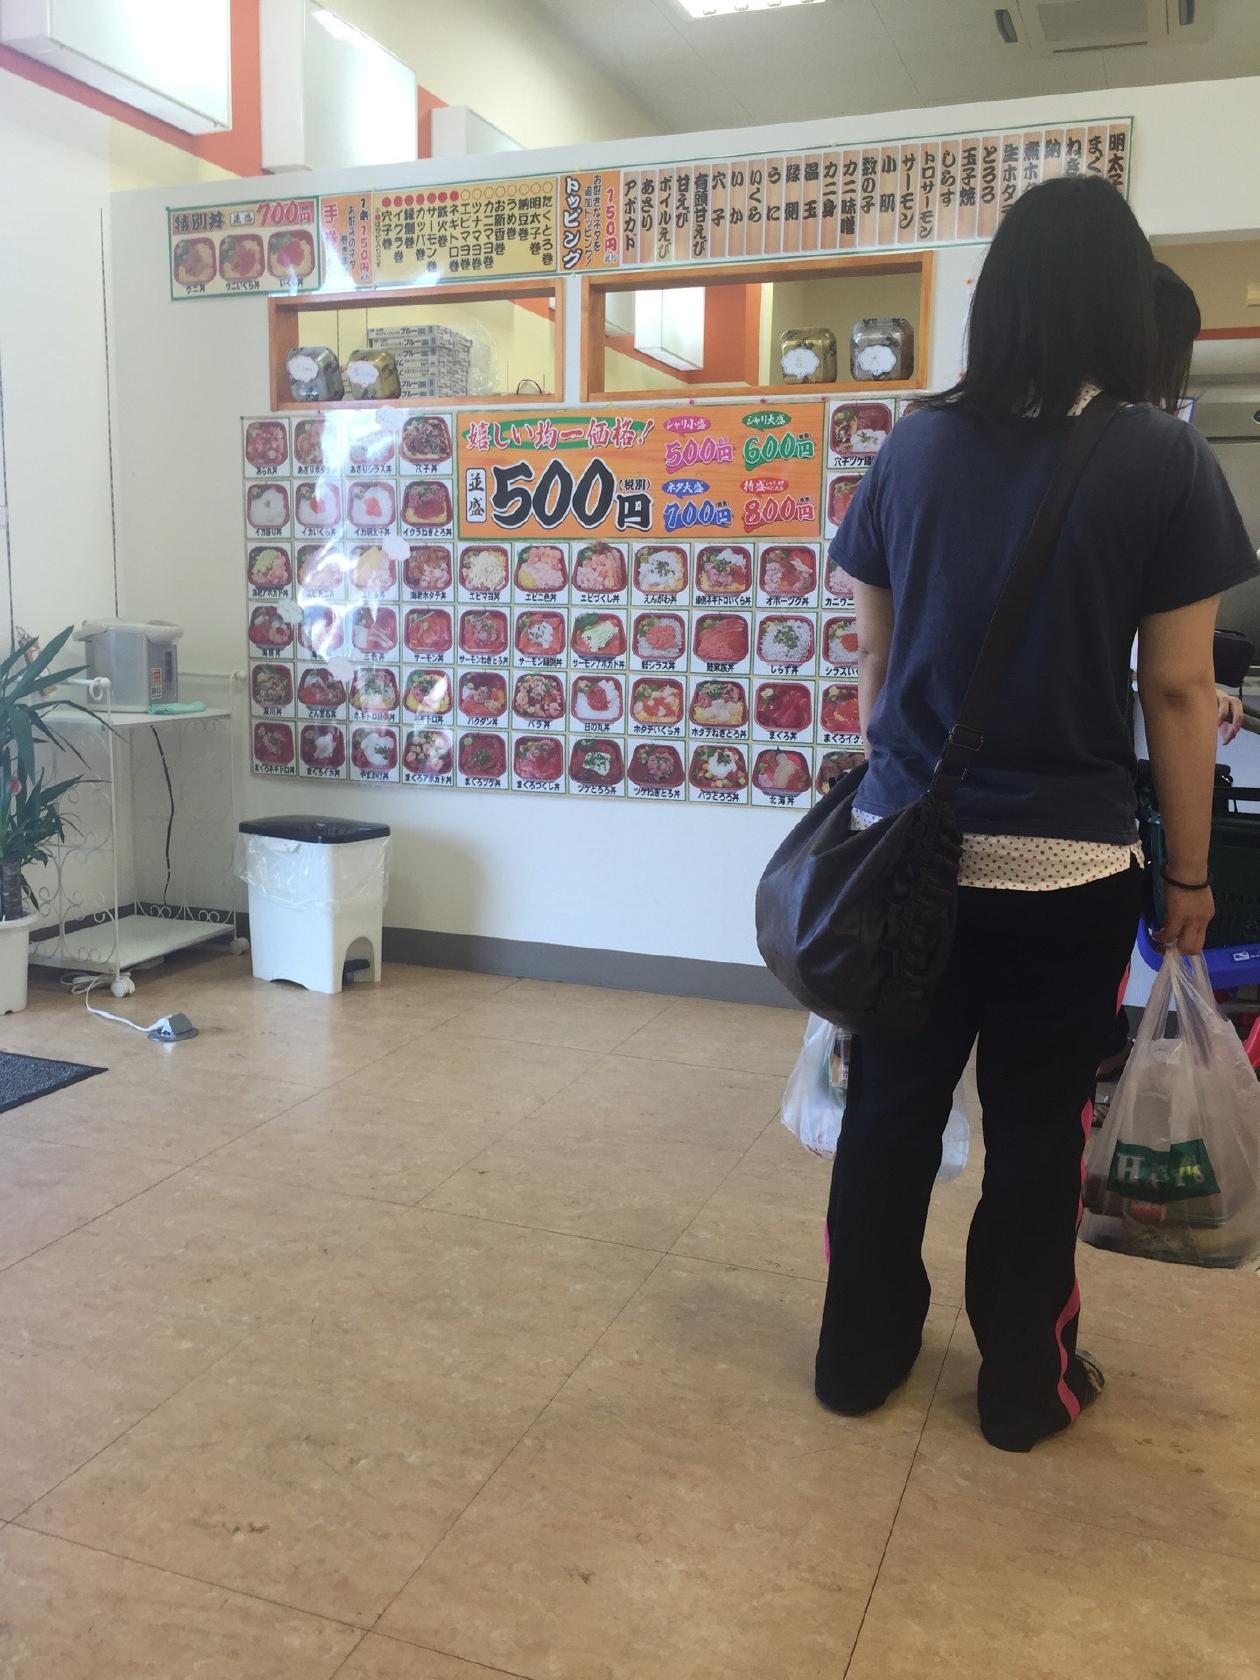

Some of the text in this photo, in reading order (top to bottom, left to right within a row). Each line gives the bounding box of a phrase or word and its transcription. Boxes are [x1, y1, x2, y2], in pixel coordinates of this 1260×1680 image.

[940, 150, 955, 207] しらす
[959, 147, 976, 206] 玉子焼
[981, 146, 997, 204] とろろ
[1087, 135, 1103, 173] まぐ
[641, 178, 654, 231] あさり
[676, 174, 690, 229] 甘えび
[712, 171, 726, 227] 穴子
[730, 171, 744, 224] いか
[749, 169, 762, 222] いくら
[767, 166, 781, 221] うに
[822, 161, 837, 218] カニ身
[841, 160, 857, 235] カニ味噌
[861, 156, 877, 213] 数の子
[880, 155, 896, 213] 小肌
[900, 153, 916, 229] サーモン
[920, 151, 935, 238] トロサーモン
[175, 211, 224, 231] 特別丼
[382, 210, 392, 250] 穴子巻
[394, 209, 404, 263] イクラ巻
[449, 204, 459, 272] ネギトロ巻
[460, 202, 471, 270] エビマヨ巻
[472, 201, 482, 270] ツナマヨ巻
[483, 200, 494, 269] カニマヨ巻
[495, 201, 506, 255] お新香巻
[507, 199, 517, 240] うめ巻
[518, 198, 529, 241] 納豆巻
[530, 197, 541, 255] 明太子巻
[562, 175, 583, 270] トッピング
[593, 174, 602, 252] お好きなネタを
[604, 187, 618, 252] 150円
[624, 179, 637, 251] アボカド
[658, 175, 672, 259] ボイルえび
[466, 416, 656, 451] 嬉しい均一価格!
[665, 436, 734, 468] 500円
[743, 432, 815, 464] 600円
[415, 464, 437, 473] 穴子丼
[467, 472, 485, 516] 並盛
[491, 458, 655, 531] 500円
[663, 499, 733, 529] 700円
[744, 495, 815, 525] 800円
[469, 592, 500, 601] エビマヨ丼
[766, 596, 809, 606] オホーツク丼
[633, 725, 680, 736] ホタテいくら丼
[691, 726, 747, 739] ホタテねぎとろ丼
[769, 731, 797, 740] まぐろ丼
